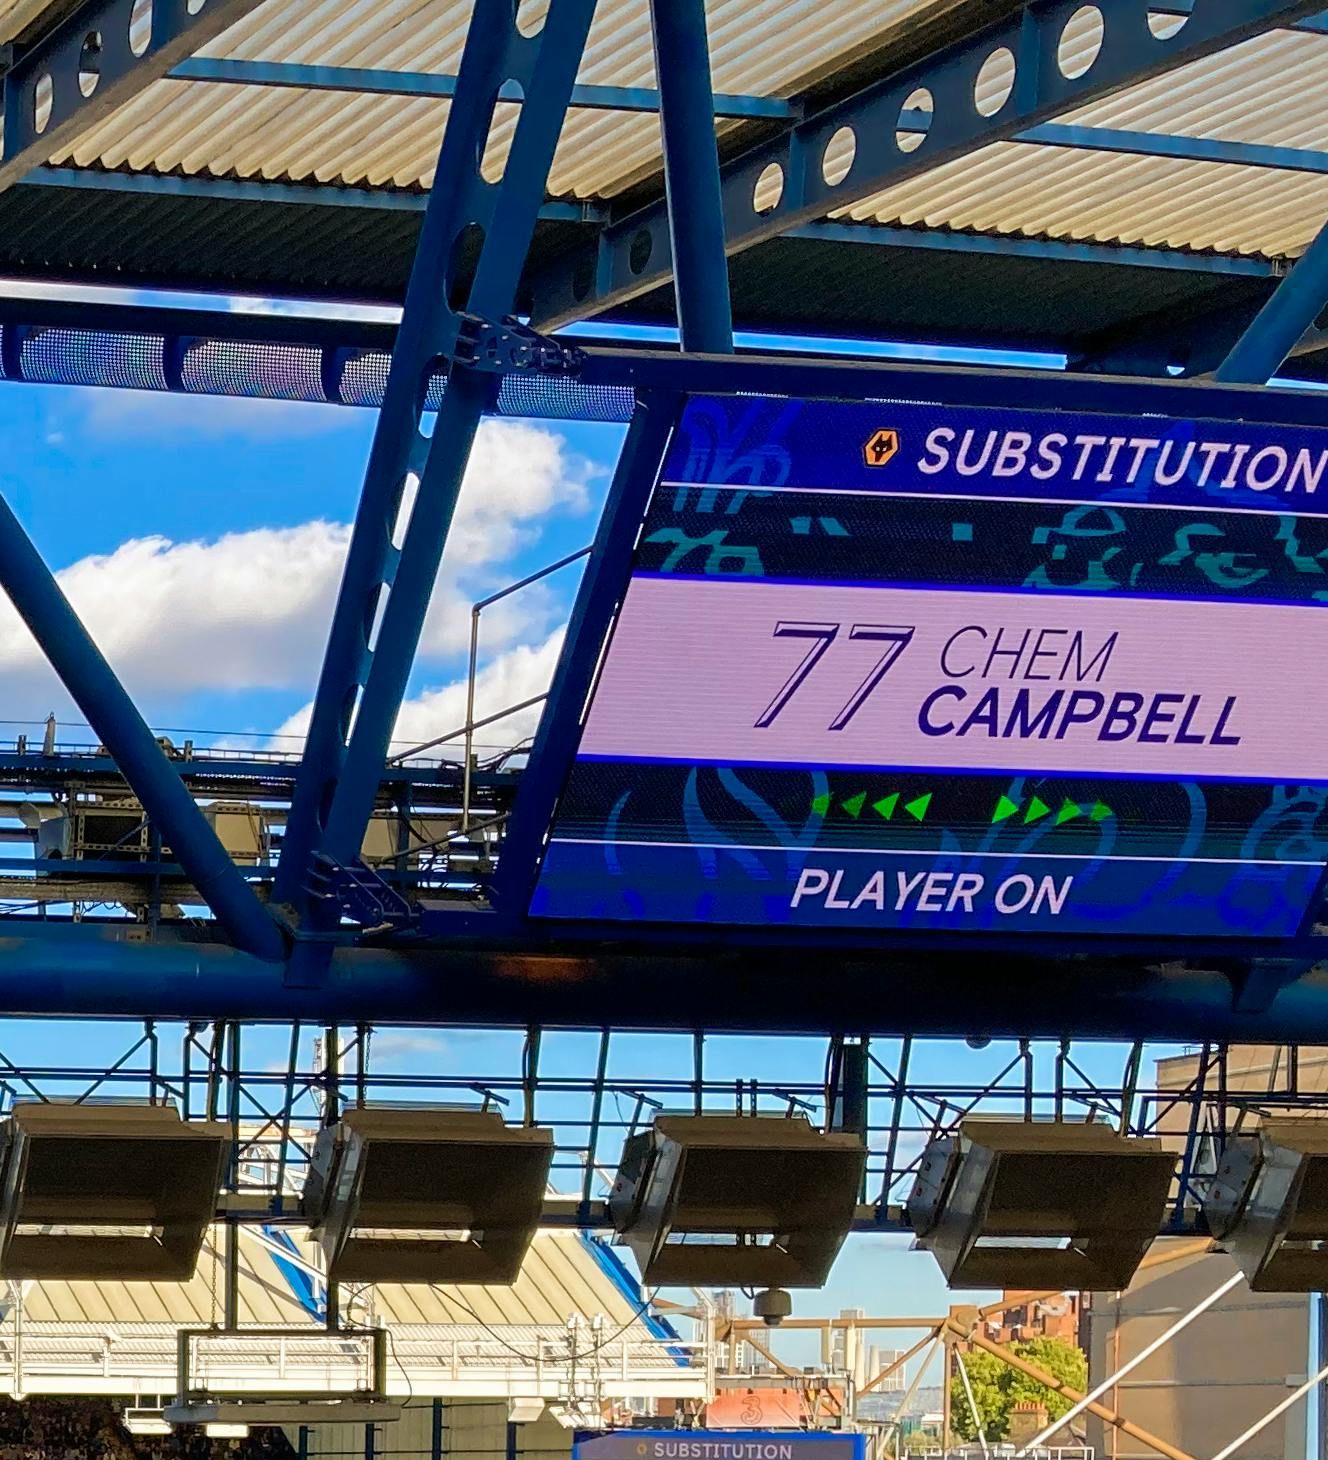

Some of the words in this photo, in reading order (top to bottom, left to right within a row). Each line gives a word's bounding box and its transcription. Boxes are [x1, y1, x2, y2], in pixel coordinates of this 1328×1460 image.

[917, 427, 1328, 494] SUBSTITUTION
[754, 620, 916, 731] 77
[940, 625, 1119, 683] CHEM
[917, 685, 1242, 745] CAMPBELL
[791, 868, 987, 914] PLAYER
[993, 875, 1074, 915] ON
[654, 1442, 792, 1460] SUBSTITUTION
